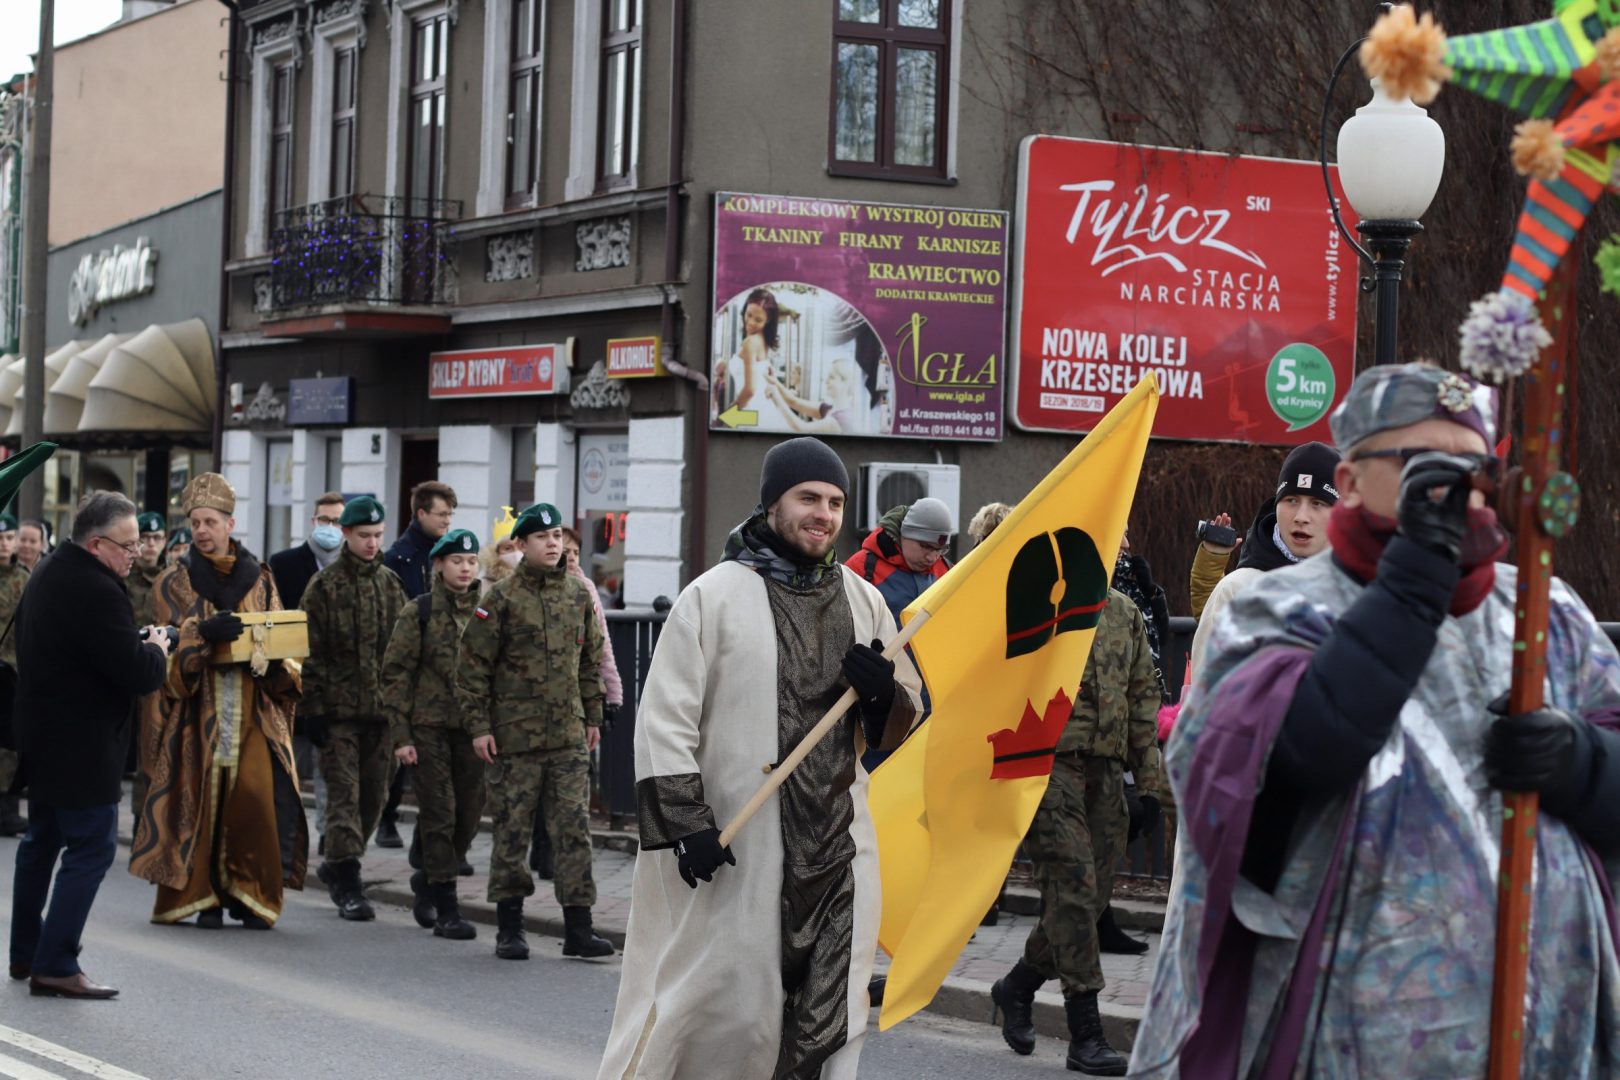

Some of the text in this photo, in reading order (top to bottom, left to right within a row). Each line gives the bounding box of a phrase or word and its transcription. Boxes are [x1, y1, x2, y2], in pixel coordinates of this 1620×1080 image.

[724, 197, 1002, 228] KOMPLEKSOWY WYSTRÓJ OKIEN
[1247, 197, 1270, 211] SKI
[743, 226, 1000, 255] TKANINY FIRANY KARNISZE
[869, 263, 1000, 286] KRAWIECTWO
[1193, 269, 1280, 293] STACJA
[876, 288, 994, 304] DODATKI KRAWIECKIE
[1121, 282, 1280, 312] NARCIARSKA
[609, 345, 656, 370] ALKOHOLE
[1043, 328, 1186, 365] NOWA KOLEJ
[432, 360, 465, 388] SKLEP
[467, 359, 506, 387] RYBNY
[1277, 359, 1327, 395] 5 km
[1277, 396, 1324, 410] od Krynicy
[900, 409, 995, 424] ul. Kraszewskiego 18
[954, 426, 970, 434] 441
